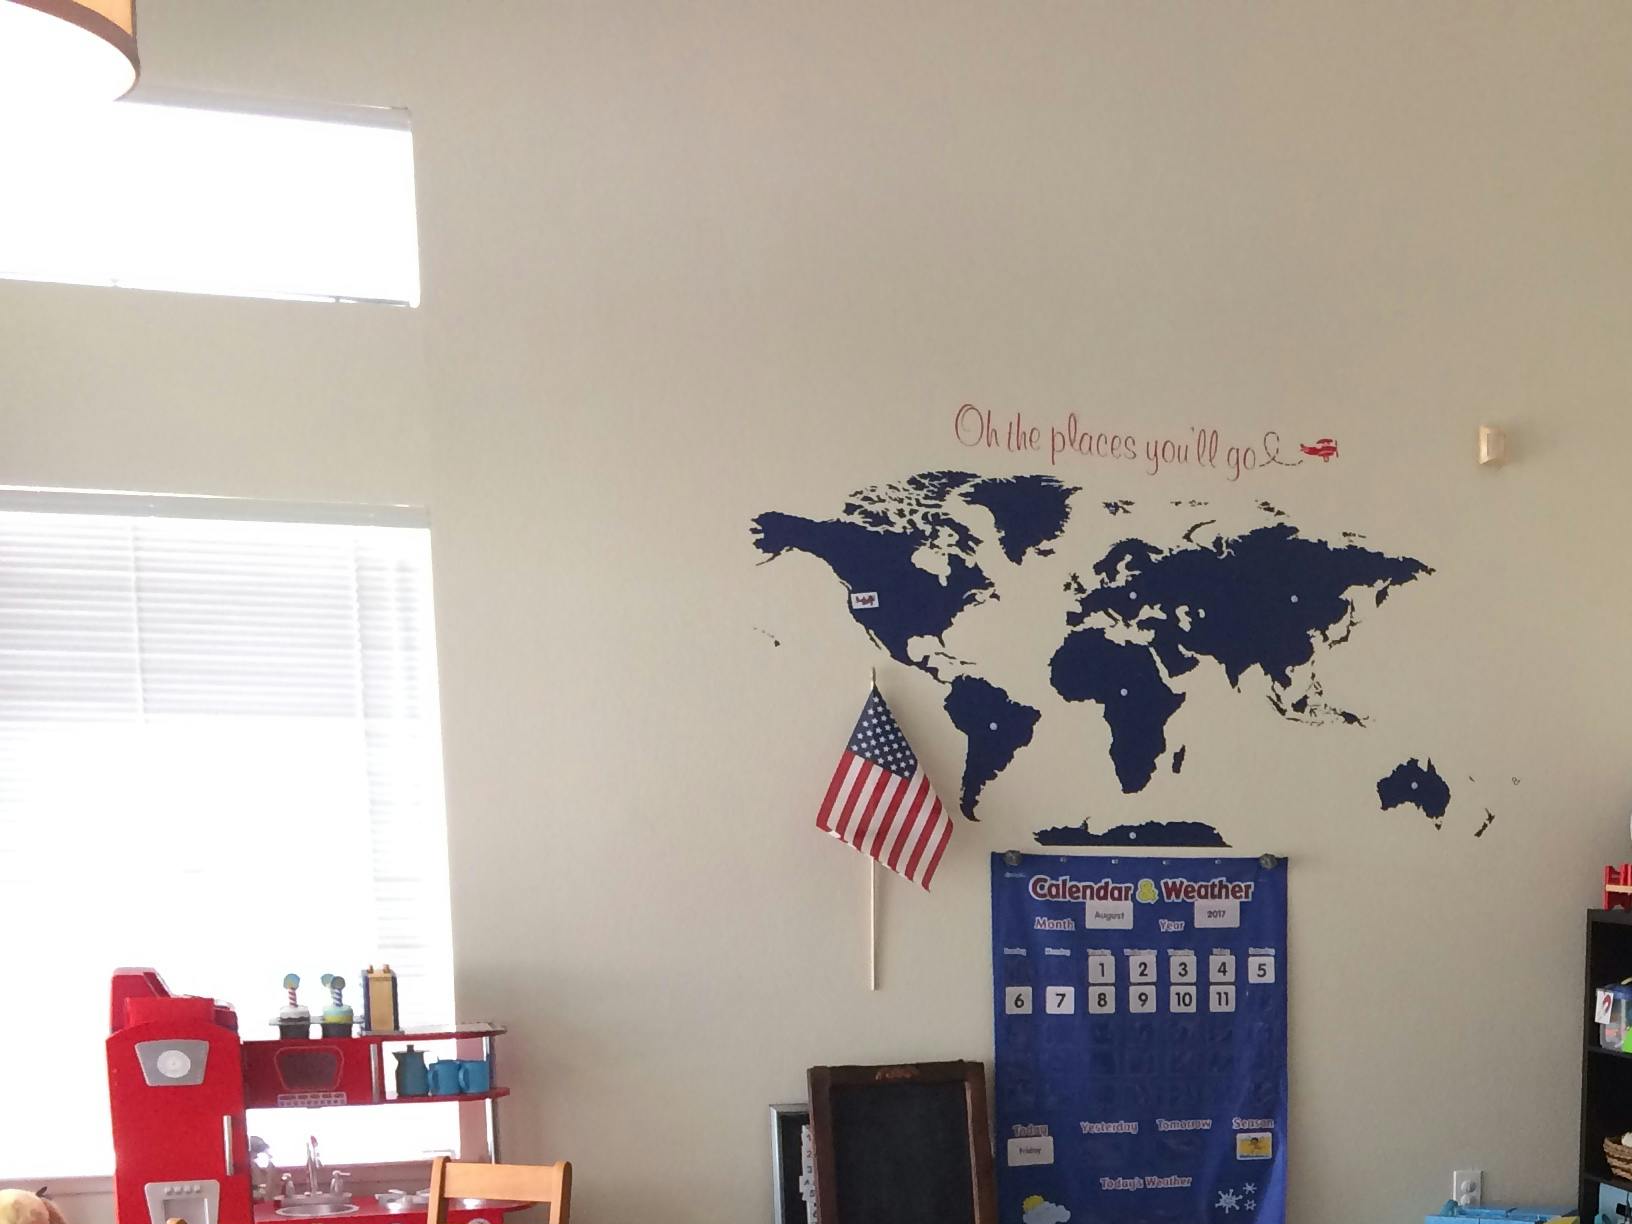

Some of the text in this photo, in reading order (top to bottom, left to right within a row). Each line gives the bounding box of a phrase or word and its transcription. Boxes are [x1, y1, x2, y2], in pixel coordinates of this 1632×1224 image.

[954, 403, 1257, 482] Oh the places you'll go
[1029, 874, 1255, 904] Calendar & Weather
[1034, 910, 1125, 931] Month August
[1158, 909, 1226, 932] Year 2017
[1098, 961, 1267, 978] 1 2 3 4 5
[1013, 992, 1230, 1009] 6 7 8 9 10 11
[1012, 1124, 1048, 1138] Today
[1080, 1119, 1139, 1135] Yesterday
[1156, 1118, 1212, 1131] Tomorrow
[1232, 1116, 1275, 1129] Season
[1099, 1175, 1193, 1192] Today's Weather
